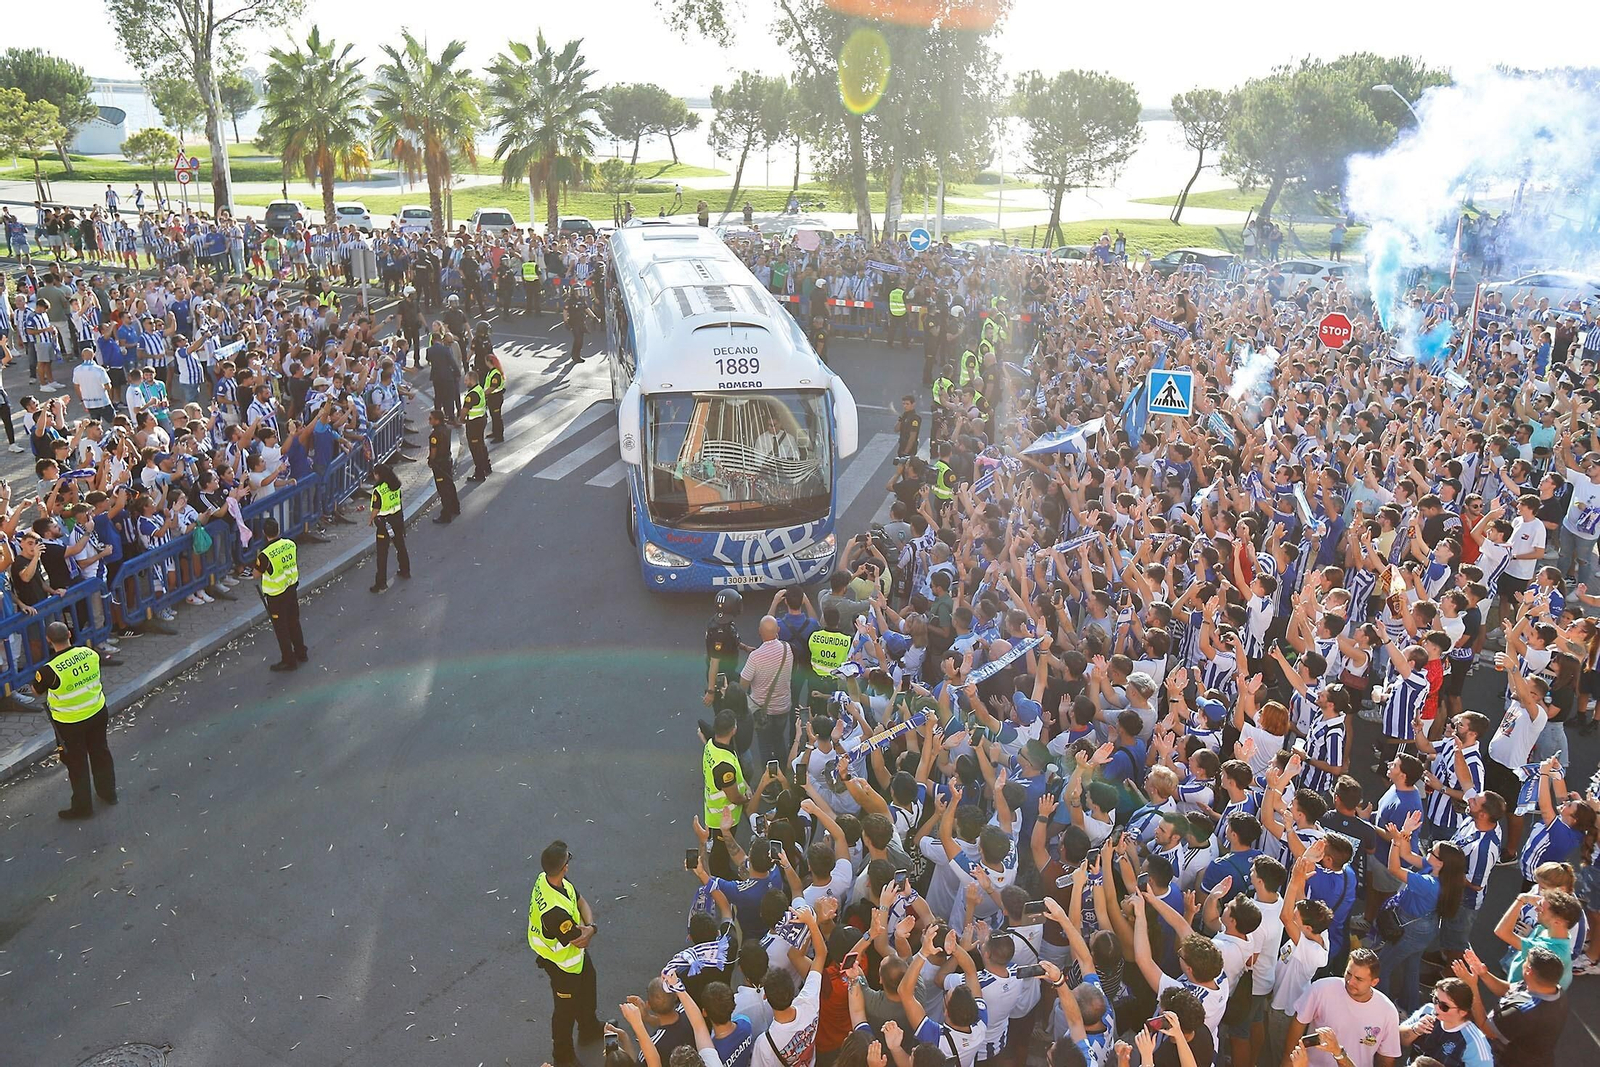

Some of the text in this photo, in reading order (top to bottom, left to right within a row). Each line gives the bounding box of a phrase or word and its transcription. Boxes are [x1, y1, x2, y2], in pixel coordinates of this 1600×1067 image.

[1321, 325, 1349, 337] STOP
[713, 346, 758, 356] DECANO
[715, 357, 760, 375] 1889
[718, 381, 763, 389] ROMERO
[281, 553, 293, 563] 020
[728, 576, 747, 584] 3003
[812, 634, 849, 648] SEGURIDAD
[820, 649, 836, 659] 004
[55, 649, 93, 672] SEGURIDAD
[817, 659, 841, 668] PROSEG
[72, 662, 90, 677] 015
[725, 1036, 752, 1067] DECANO
